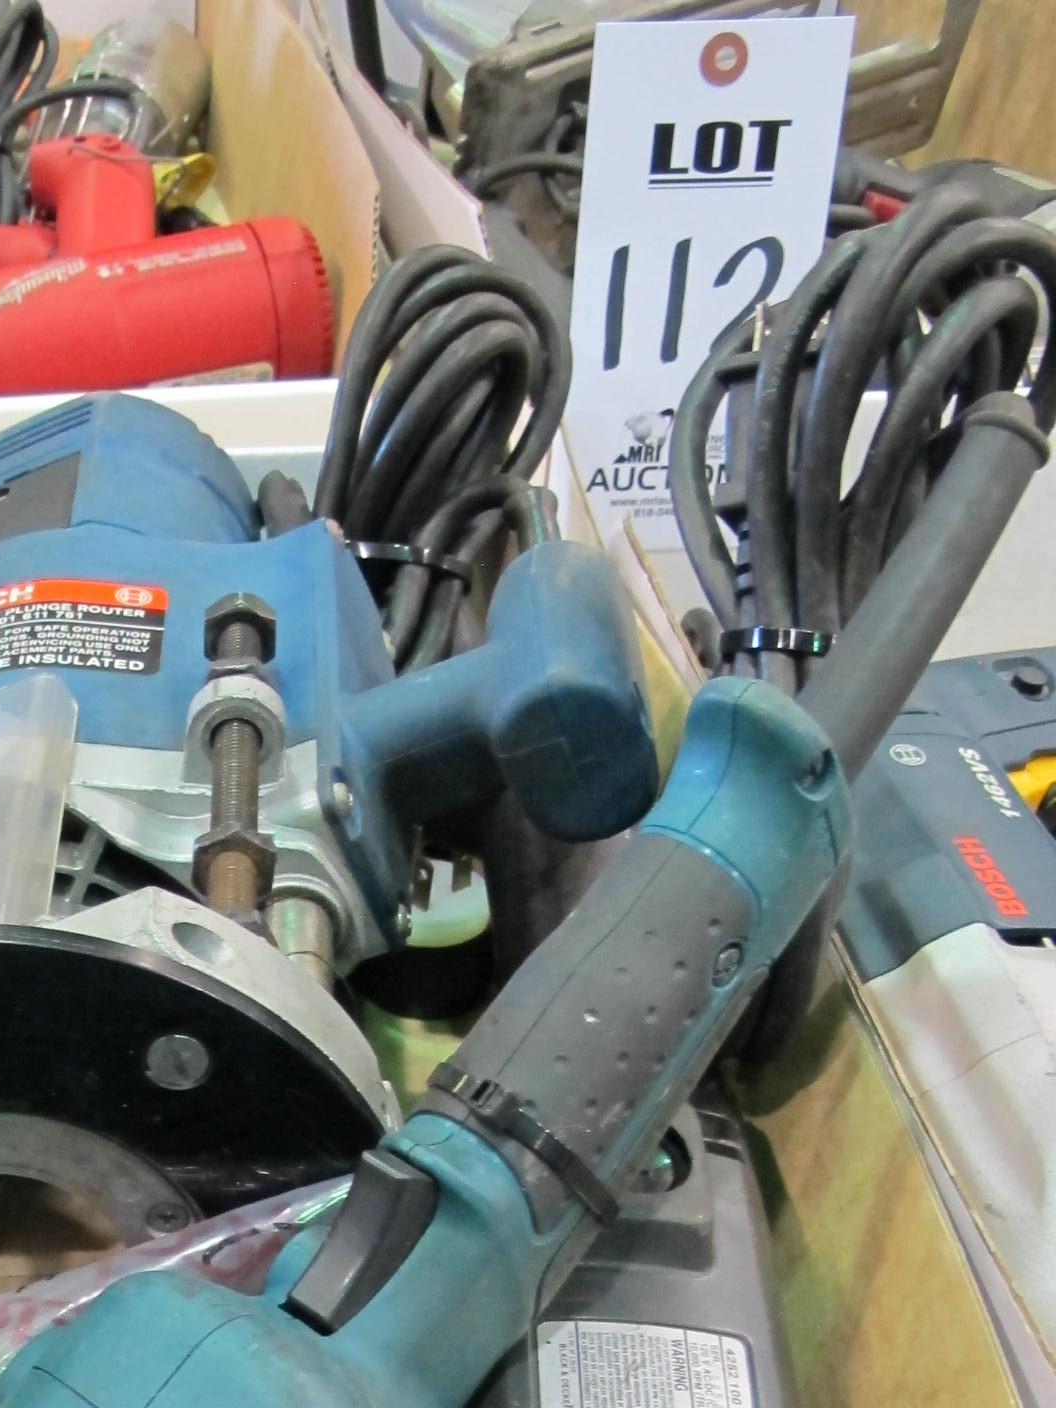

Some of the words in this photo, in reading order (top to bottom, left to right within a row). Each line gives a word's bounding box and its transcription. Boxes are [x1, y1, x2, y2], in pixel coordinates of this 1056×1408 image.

[648, 119, 794, 176] LOT
[602, 235, 785, 372] 112
[628, 444, 664, 464] MRI
[5, 602, 73, 615] PLUNGE
[76, 604, 146, 618] ROUTER
[4, 625, 32, 637] FOR
[33, 624, 70, 633] SAFE
[72, 626, 151, 639] OPERATION
[36, 631, 119, 644] GROUNDING
[121, 638, 151, 648] NOT
[11, 639, 84, 650] SERVICING
[85, 641, 114, 651] USE
[114, 643, 151, 653] ONLY
[68, 647, 117, 658] PARTS.
[17, 653, 146, 671] INSULATED
[957, 746, 1022, 820] 1462VS
[953, 836, 1029, 919] BOSCH
[559, 1344, 569, 1368] BLACK
[670, 1339, 688, 1392] WARNING
